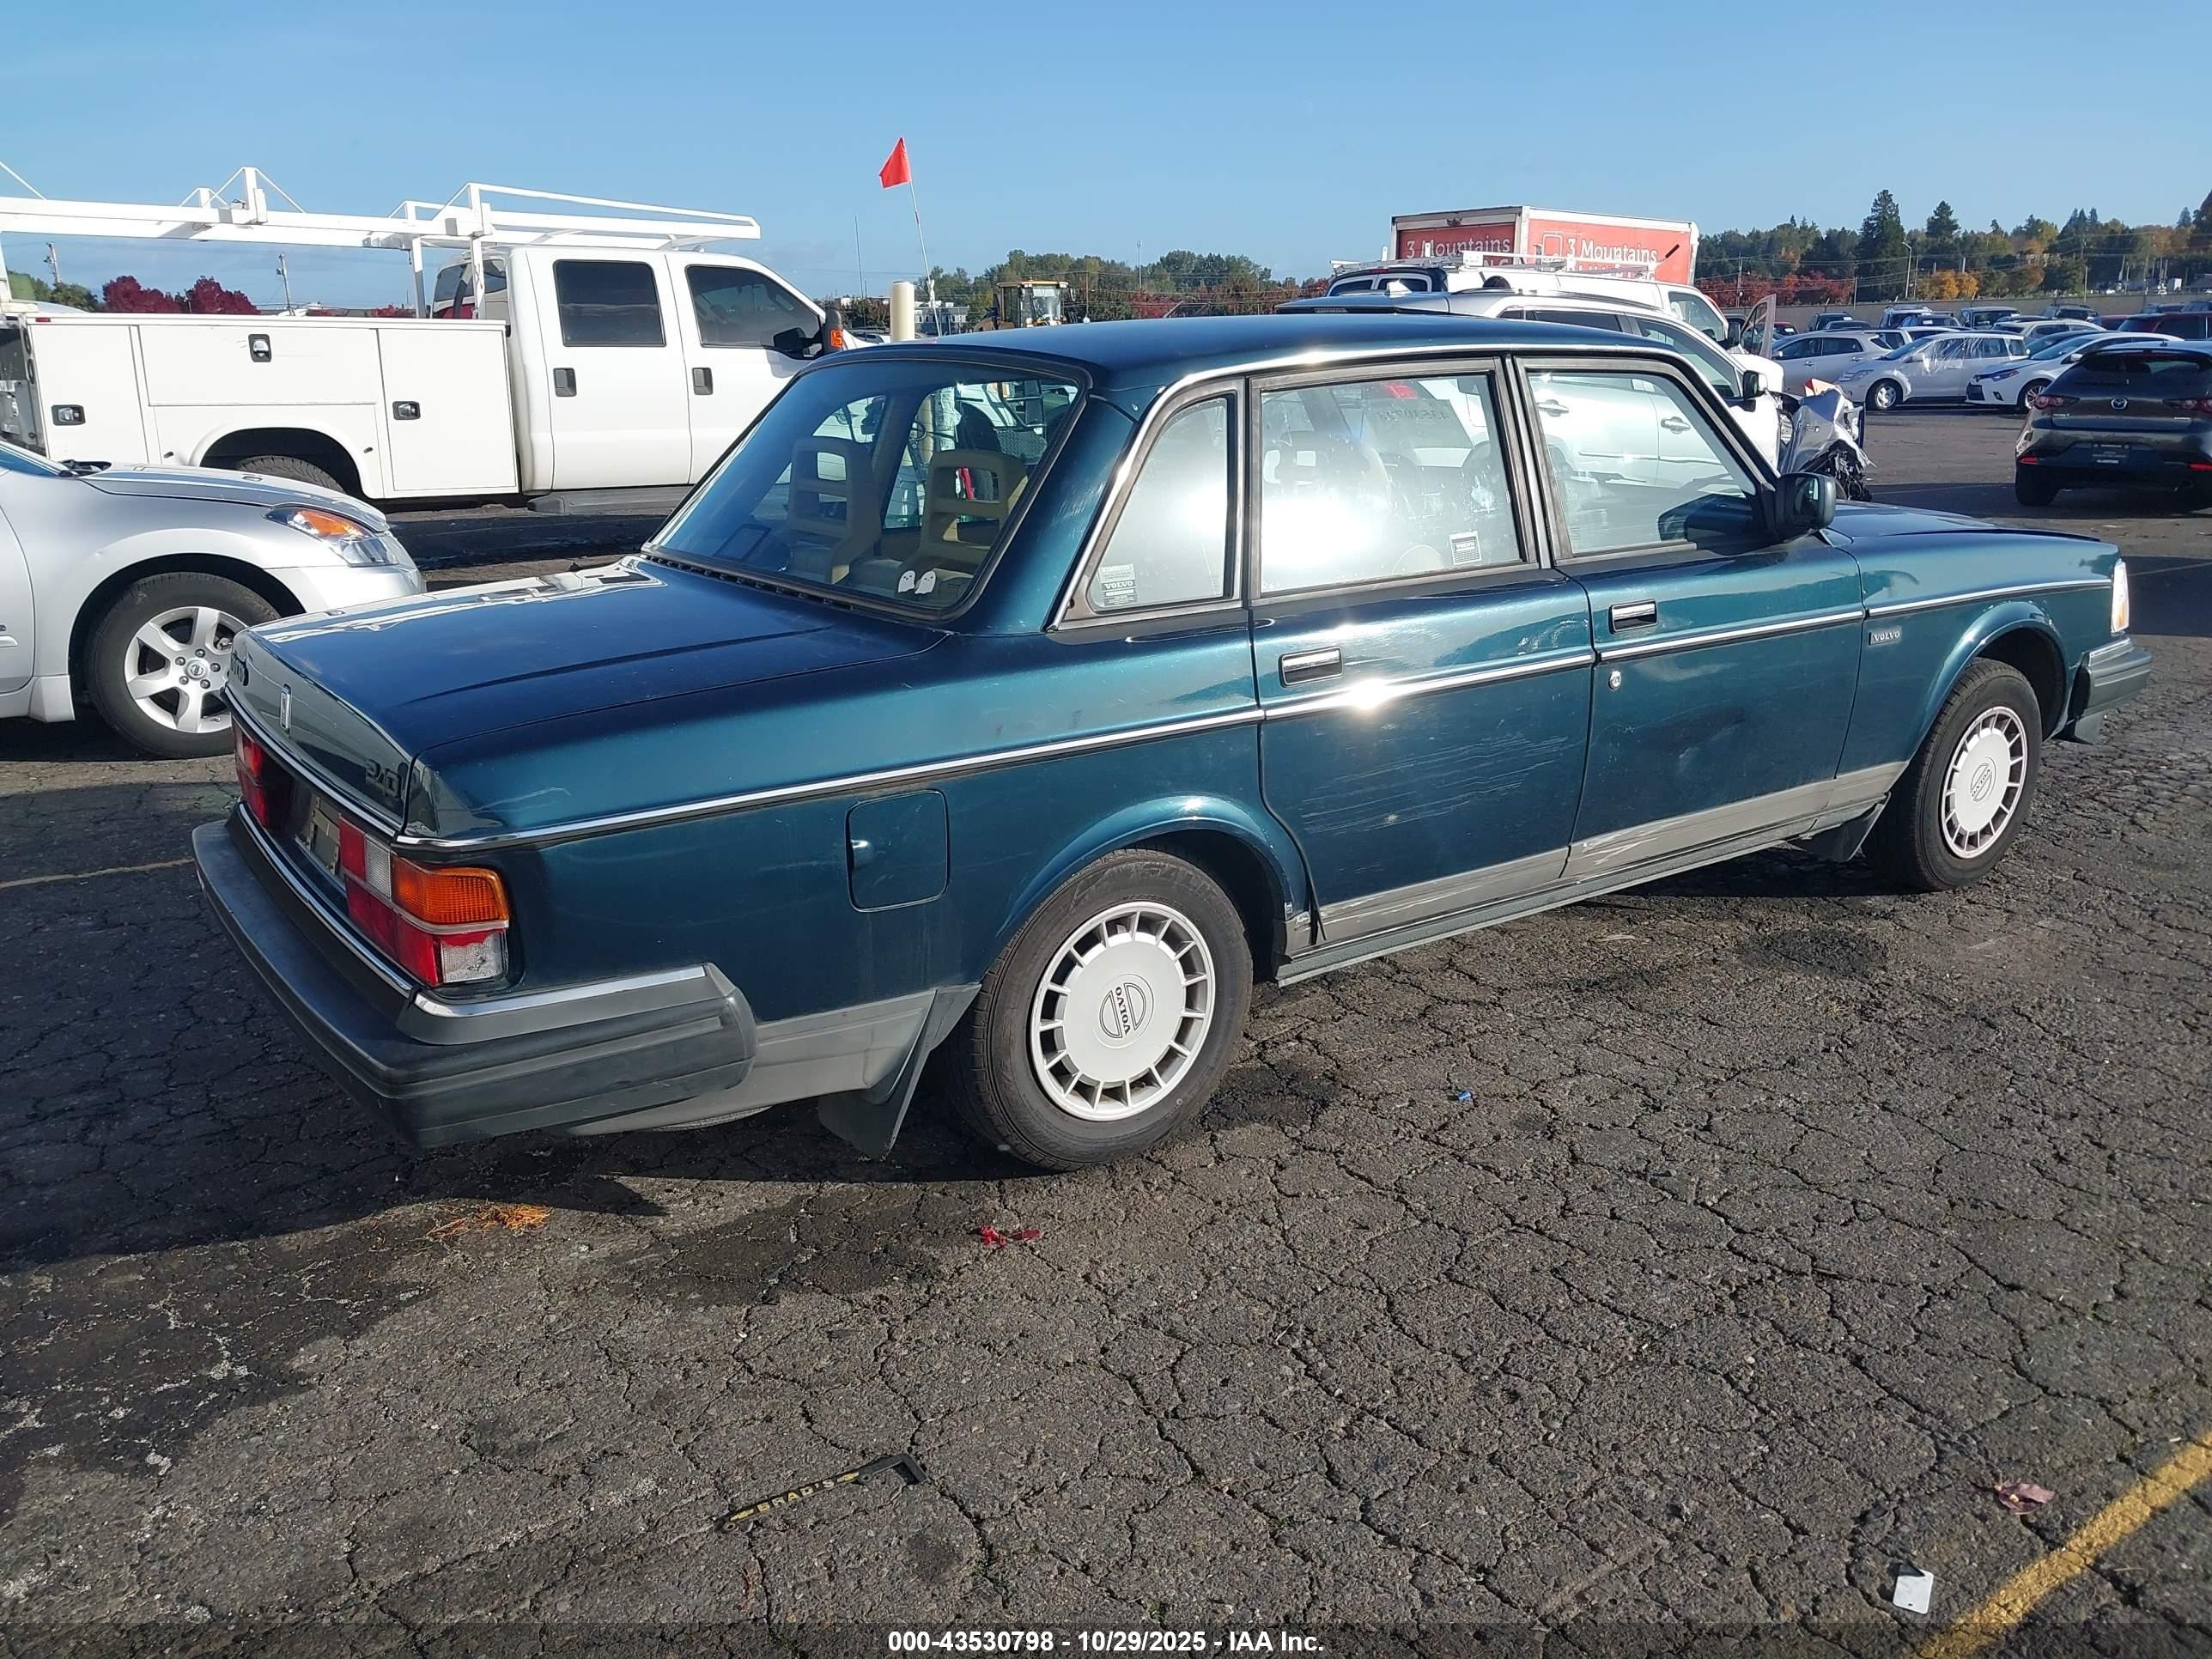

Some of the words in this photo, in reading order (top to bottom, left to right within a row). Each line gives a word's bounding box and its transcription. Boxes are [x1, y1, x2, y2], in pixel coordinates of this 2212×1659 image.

[1407, 240, 1416, 258] 3
[1421, 235, 1511, 258] Mountains
[1567, 238, 1577, 258] 3
[1580, 239, 1660, 263] Mountains
[1104, 580, 1133, 590] VOLVO
[1874, 630, 1900, 642] VOLVO
[1115, 986, 1131, 1036] VOLVO
[757, 1479, 835, 1513] BRAD'S
